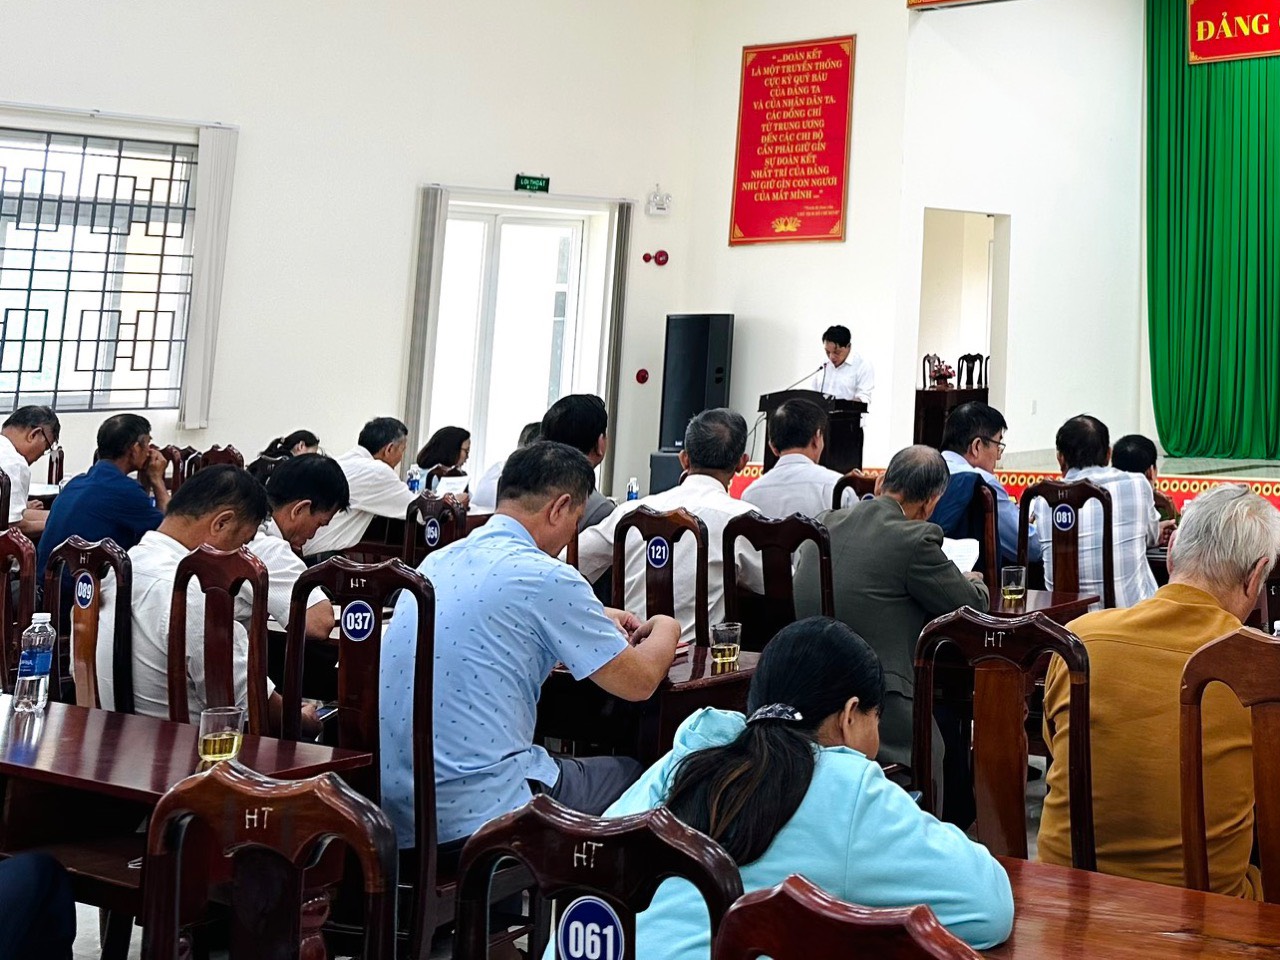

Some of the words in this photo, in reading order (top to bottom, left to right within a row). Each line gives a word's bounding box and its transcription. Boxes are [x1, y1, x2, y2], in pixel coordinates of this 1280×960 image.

[1195, 8, 1270, 43] ĐẢNG
[1056, 511, 1072, 524] 081
[651, 545, 666, 559] 121
[77, 582, 92, 600] 089
[346, 612, 371, 630] 037
[984, 631, 1006, 648] HT
[245, 806, 273, 829] HT
[573, 841, 604, 868] HT
[569, 920, 614, 960] 061
